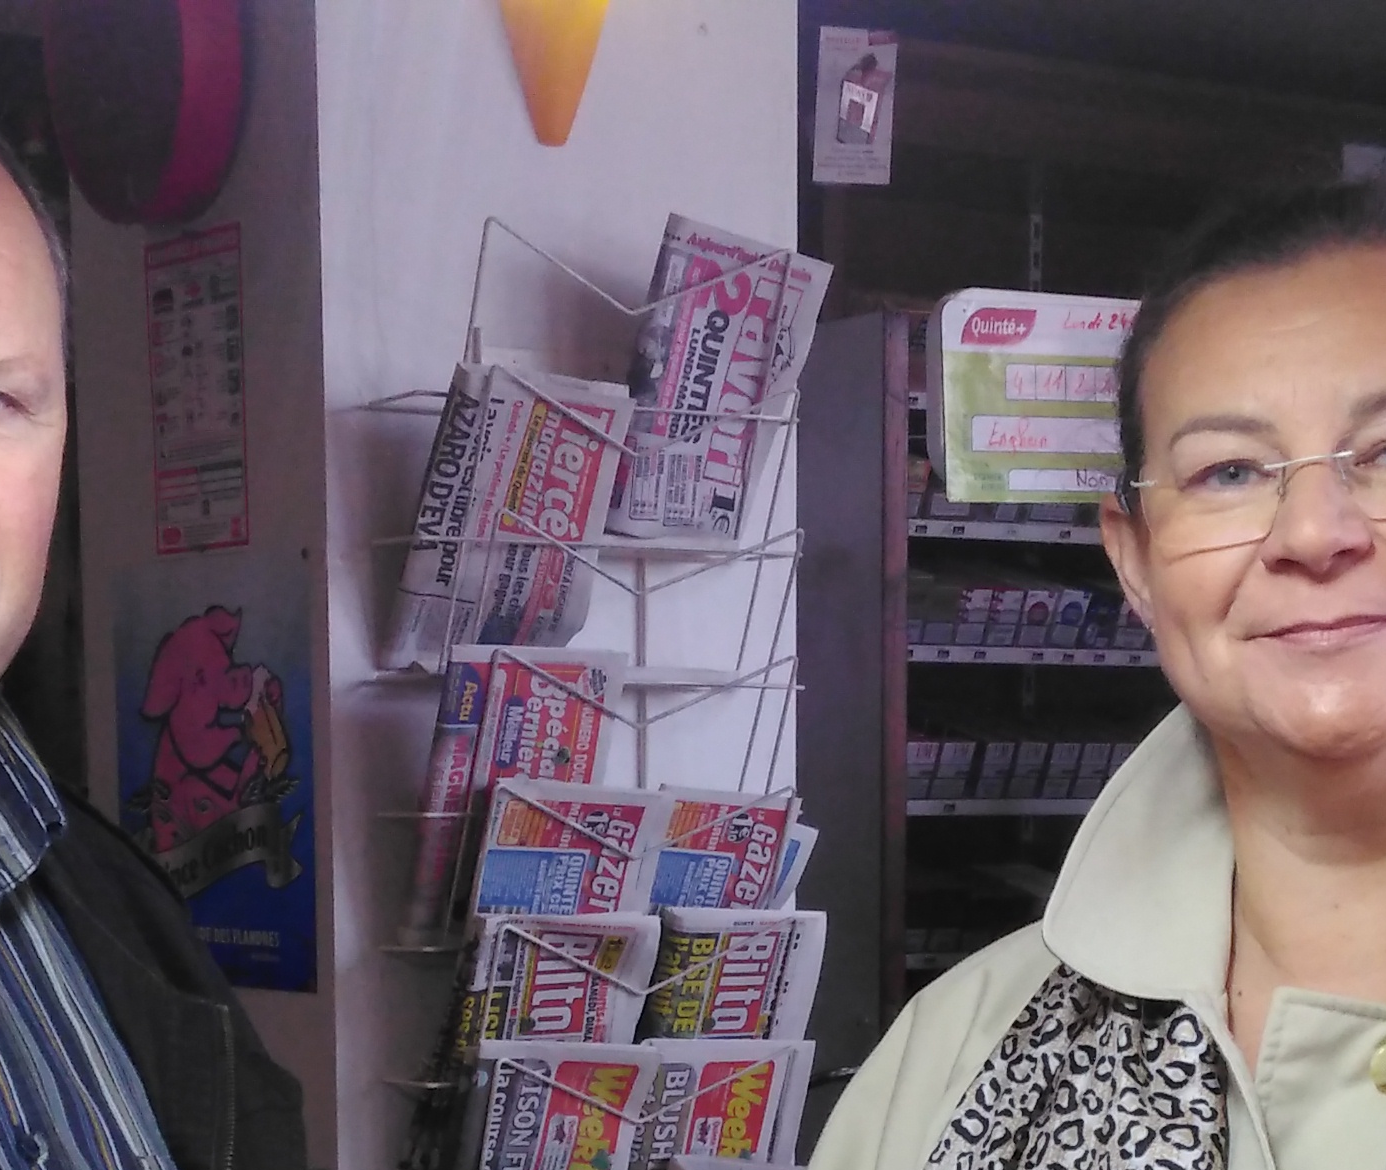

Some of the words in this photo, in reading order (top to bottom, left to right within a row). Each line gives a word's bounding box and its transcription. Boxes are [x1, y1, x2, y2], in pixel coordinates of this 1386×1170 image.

[971, 316, 1026, 335] Quinté+
[459, 680, 478, 722] Actu
[711, 934, 777, 1032] Bilto
